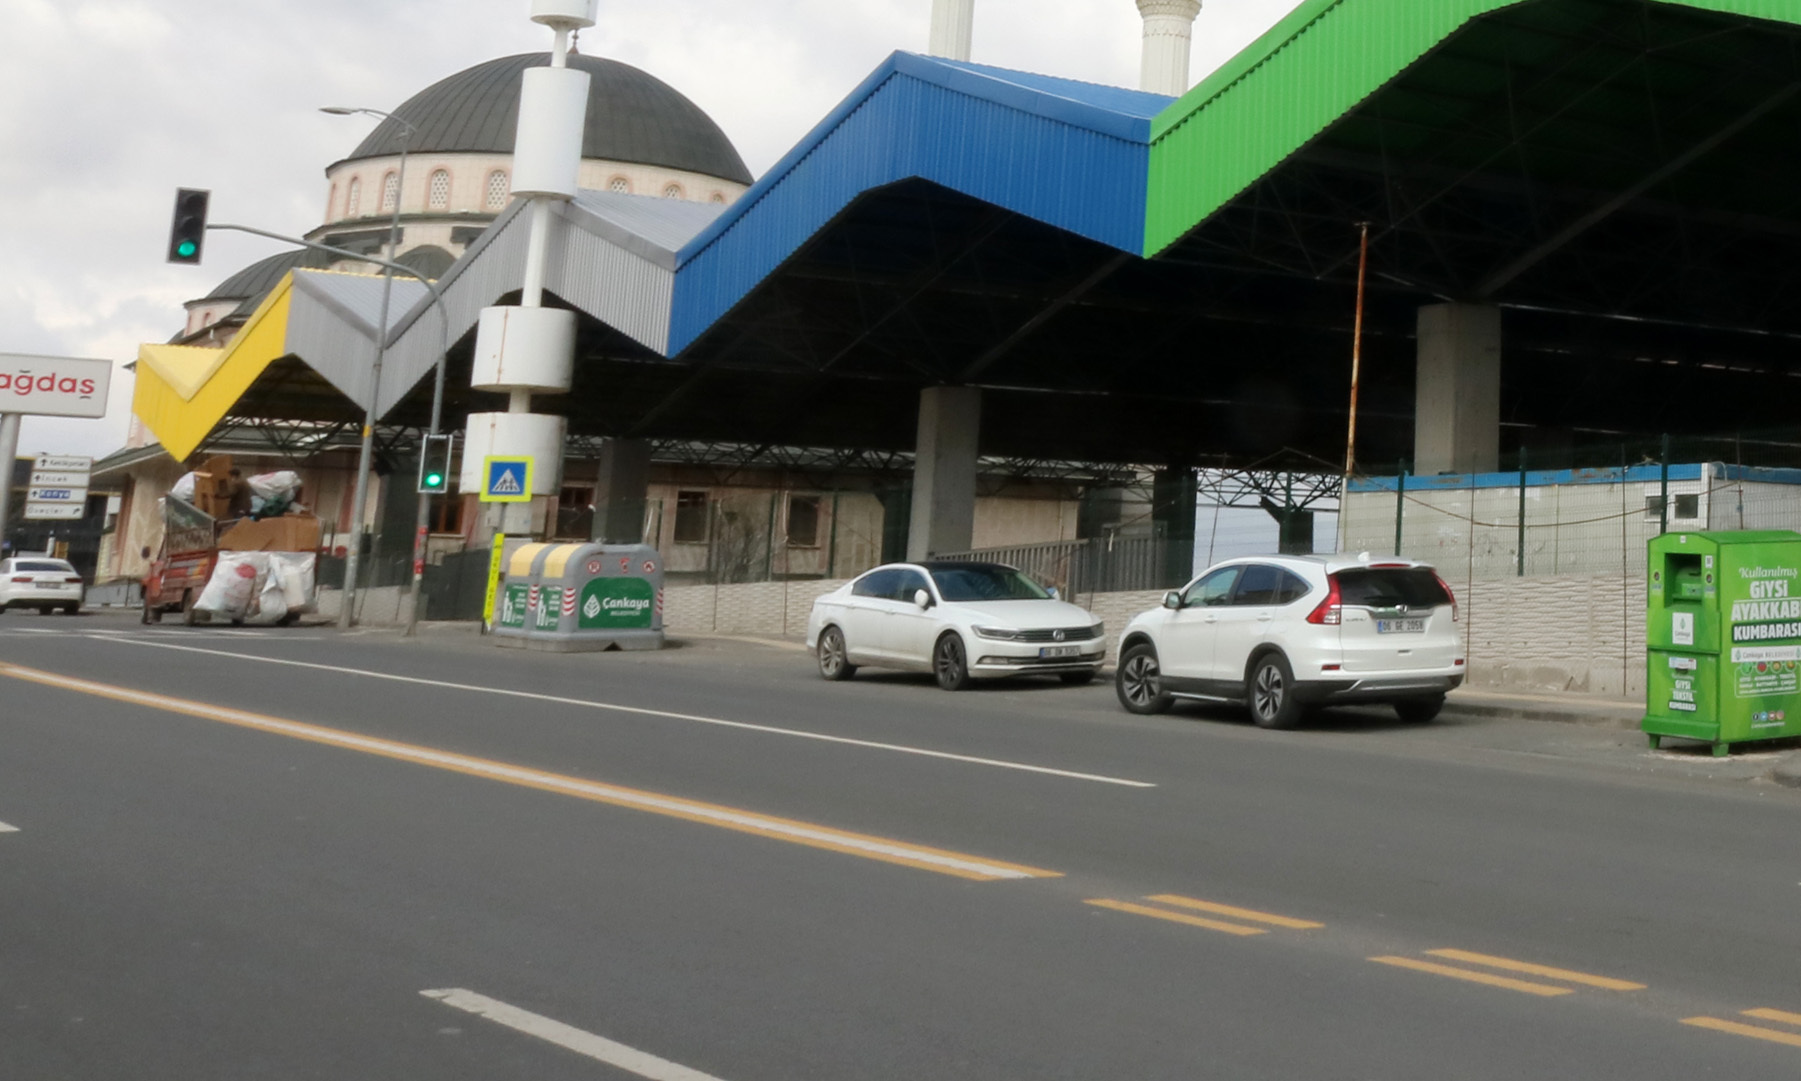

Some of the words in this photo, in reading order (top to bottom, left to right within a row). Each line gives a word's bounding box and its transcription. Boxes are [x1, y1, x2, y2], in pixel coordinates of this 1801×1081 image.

[1739, 565, 1798, 579] Kullanılmış
[602, 596, 649, 610] Çankaya
[1733, 622, 1801, 641] KUMBARASI
